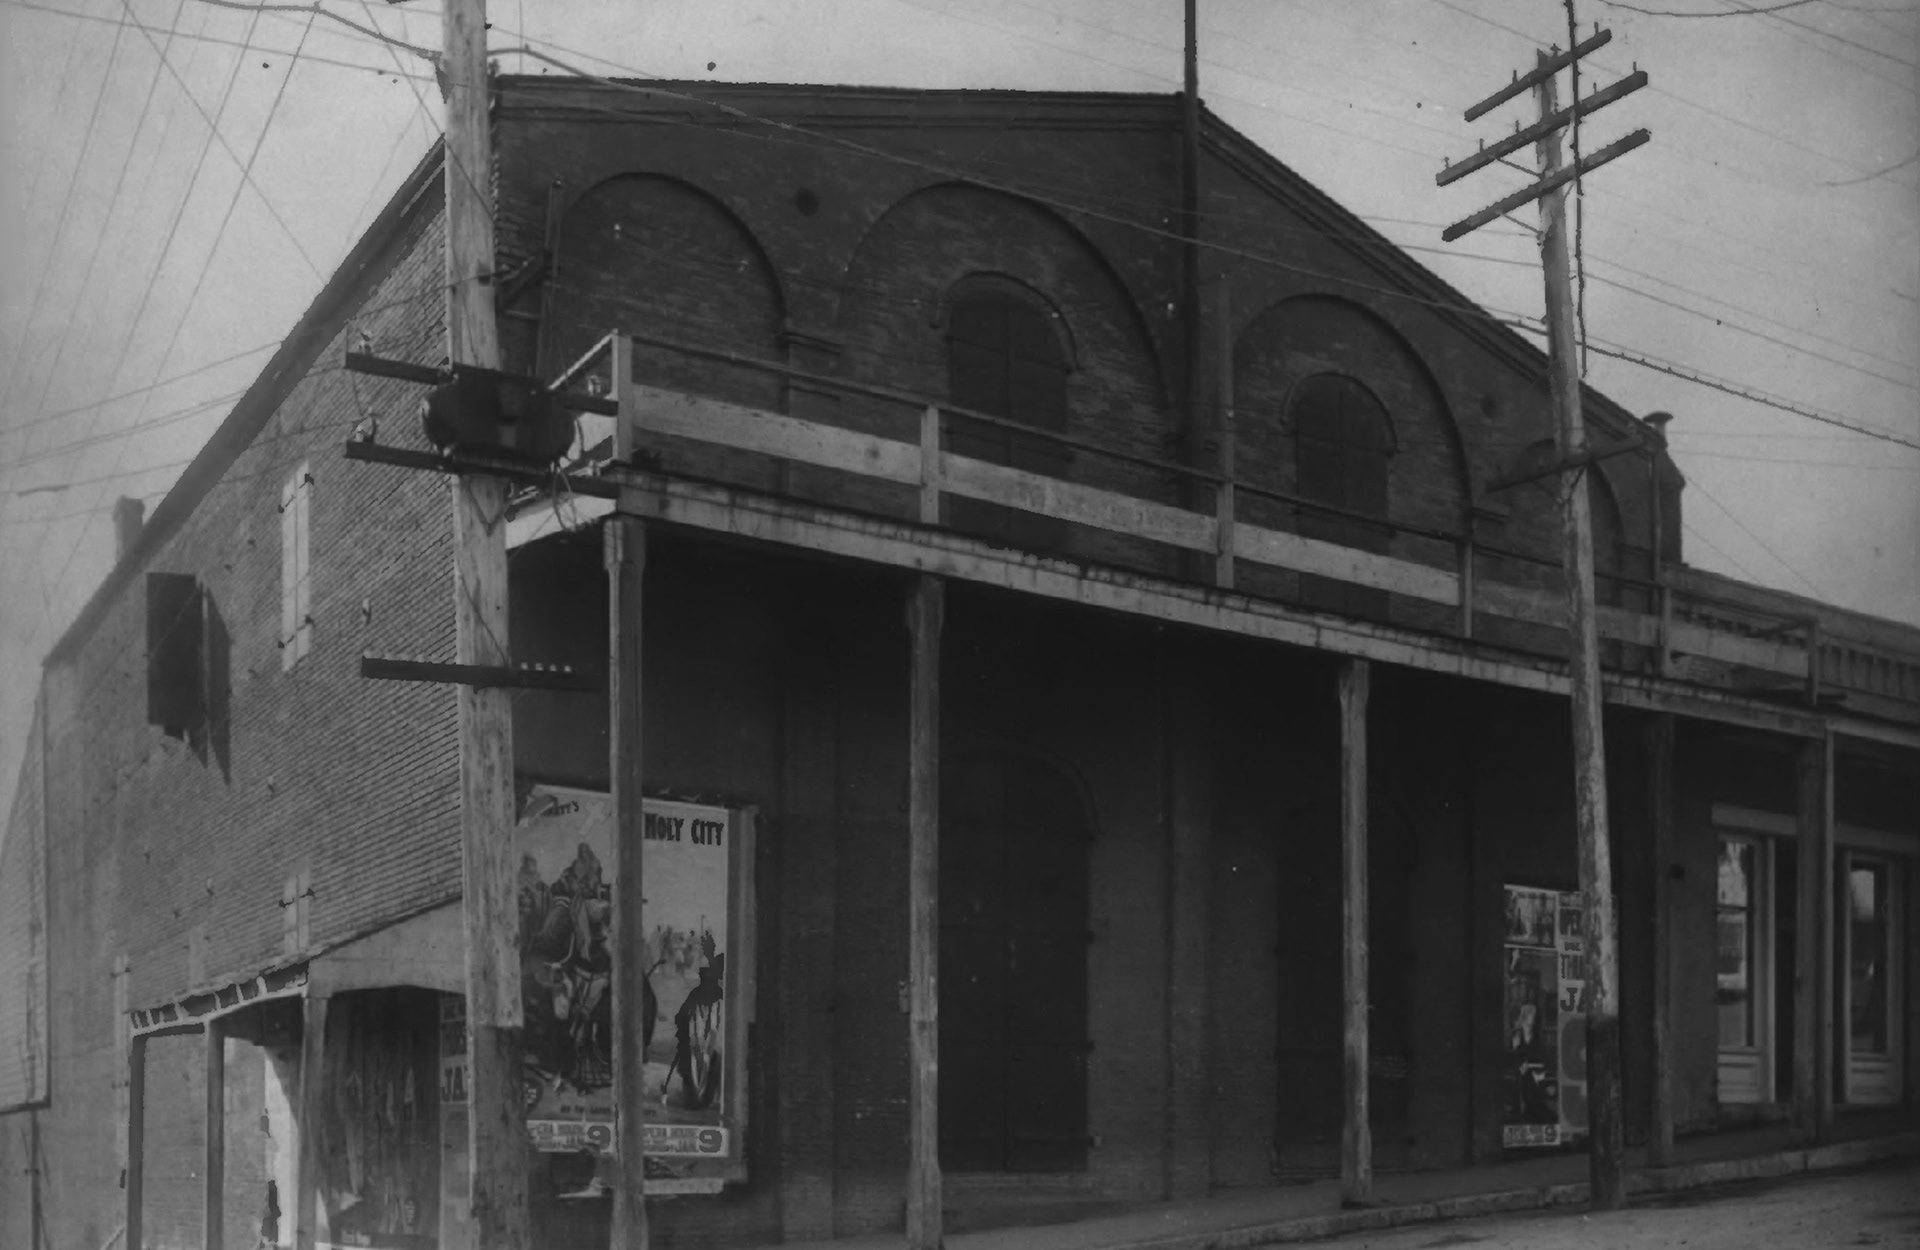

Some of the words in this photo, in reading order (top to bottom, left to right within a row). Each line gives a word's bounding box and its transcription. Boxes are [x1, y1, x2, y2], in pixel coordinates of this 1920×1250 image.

[644, 812, 685, 842] HOLY
[690, 817, 725, 846] CITY
[440, 1065, 469, 1103] JA
[586, 1125, 612, 1151] 9
[698, 1129, 723, 1153] 9
